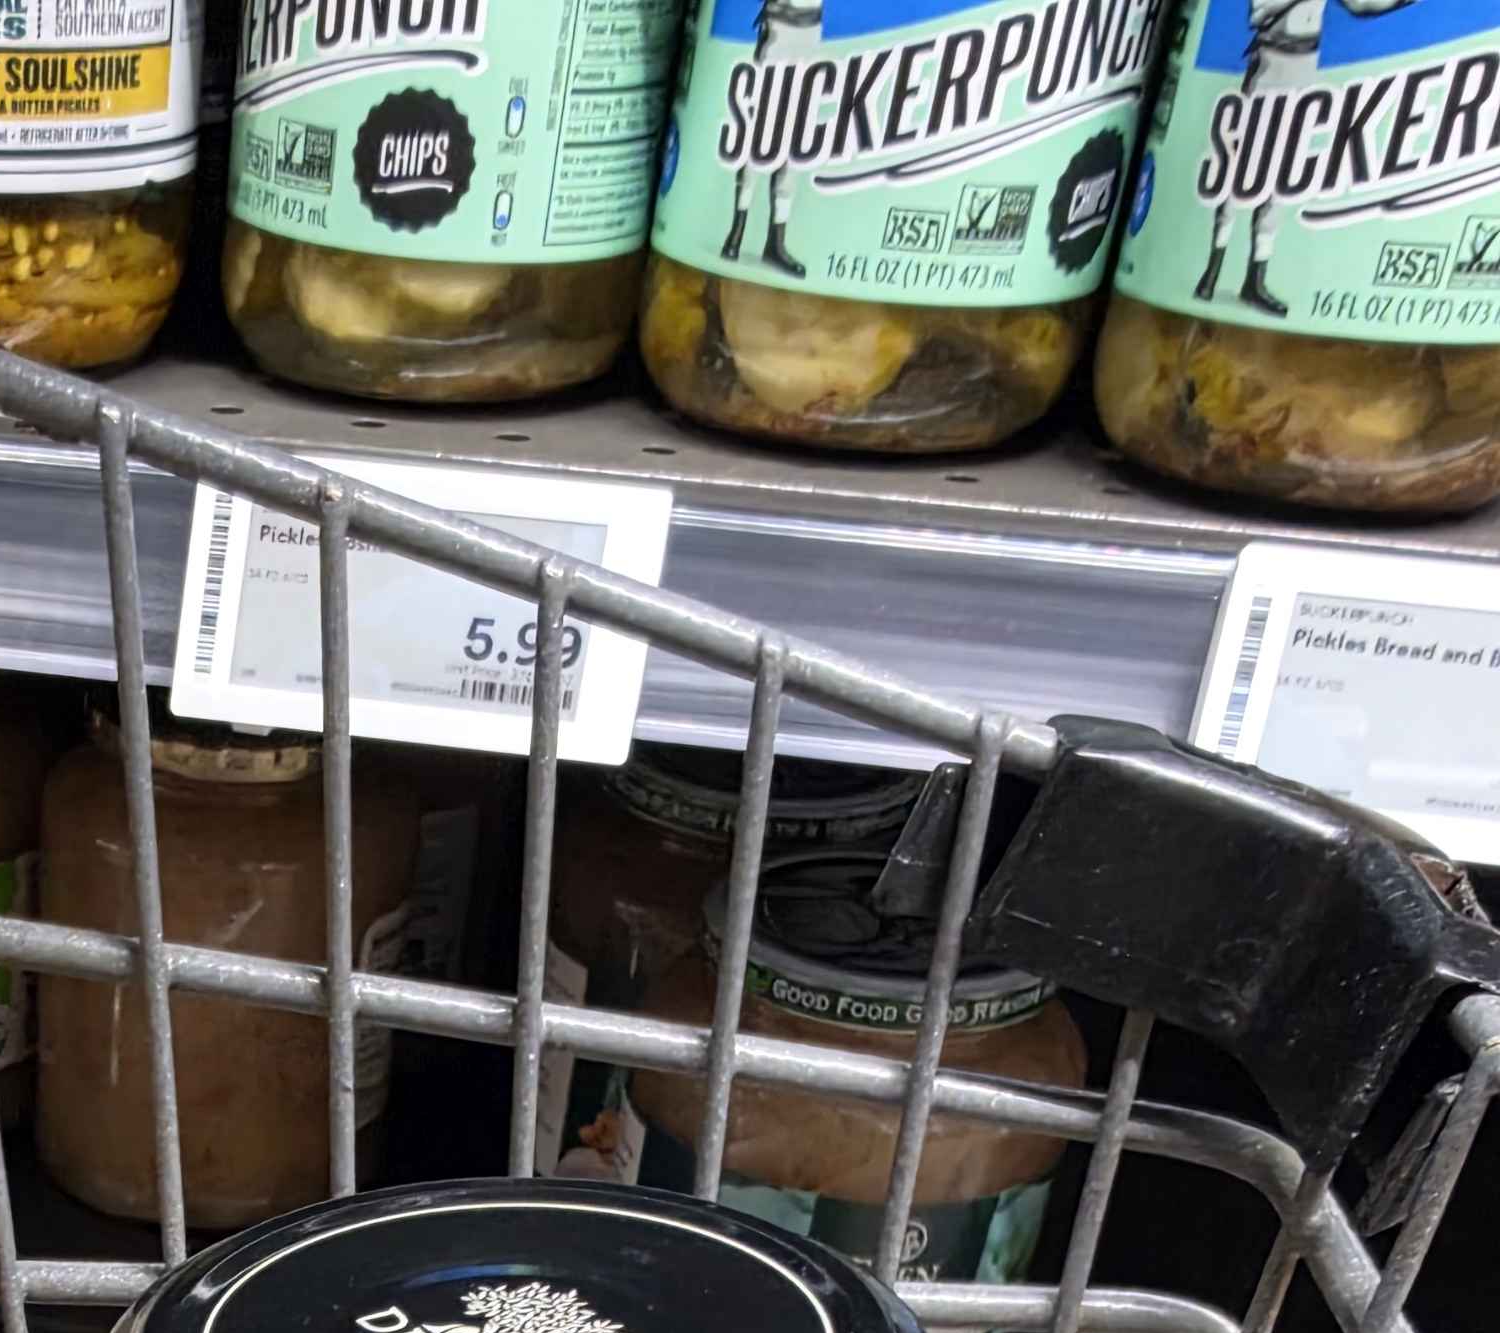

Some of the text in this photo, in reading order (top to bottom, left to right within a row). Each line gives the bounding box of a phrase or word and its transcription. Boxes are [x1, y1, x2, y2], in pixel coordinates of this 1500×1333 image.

[4, 53, 141, 93] SOULSHINE
[378, 131, 449, 178] CHIPS
[826, 254, 846, 279] 16
[850, 256, 870, 282] FL
[875, 259, 901, 285] OZ
[958, 262, 989, 289] 473
[1311, 289, 1336, 318] 16
[1337, 291, 1358, 320] FL
[1364, 293, 1394, 325] OZ
[1456, 299, 1492, 326] 473
[259, 523, 320, 547] Pickle
[463, 617, 583, 669] 5.99
[1292, 628, 1368, 655] Pickles
[1374, 636, 1439, 661] Bread
[1441, 648, 1485, 667] and
[772, 979, 830, 1011] GOOD
[836, 995, 898, 1022] FOOD
[905, 1003, 970, 1024] GD
